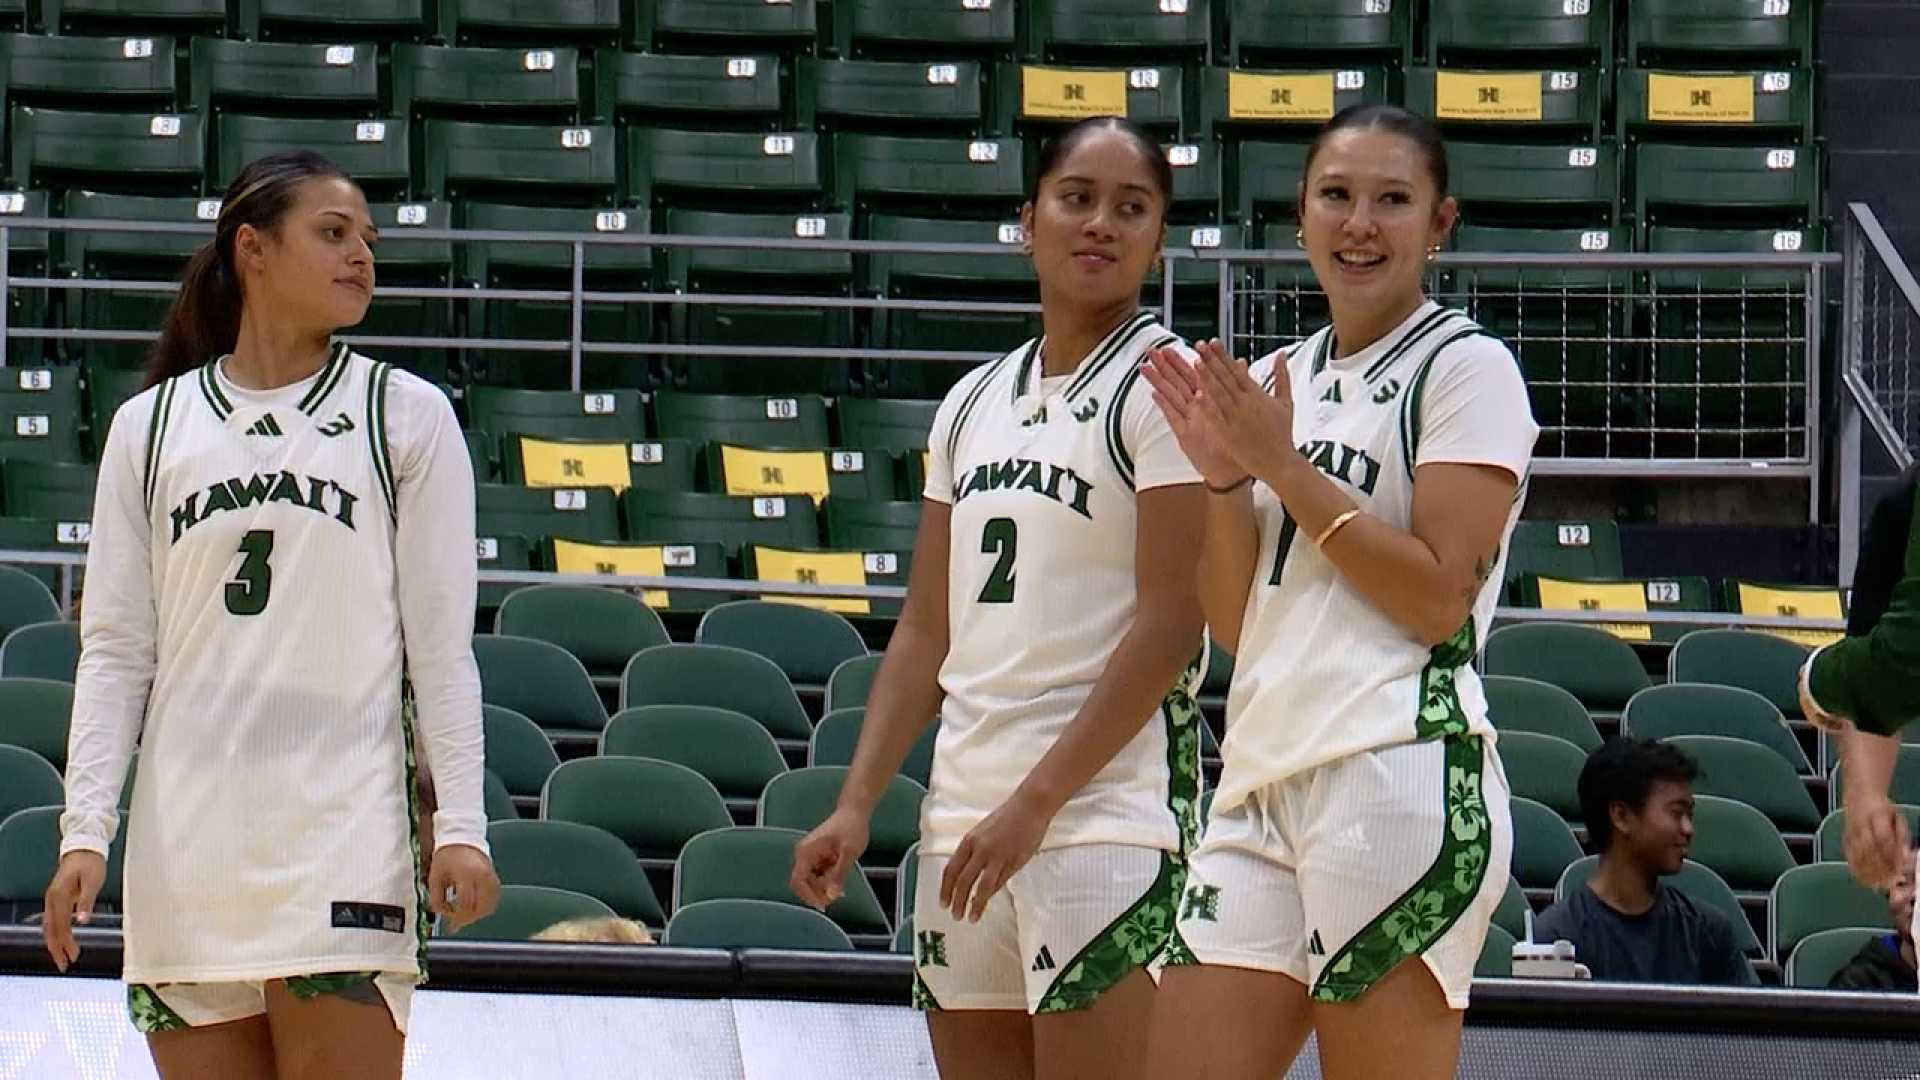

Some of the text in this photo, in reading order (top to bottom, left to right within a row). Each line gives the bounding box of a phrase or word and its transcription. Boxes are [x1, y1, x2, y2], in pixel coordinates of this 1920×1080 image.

[1138, 72, 1154, 86] 13
[1559, 74, 1573, 88] 15
[570, 131, 585, 146] 10
[775, 138, 787, 152] 11
[1576, 151, 1591, 165] 15
[1775, 152, 1790, 166] 16
[207, 203, 217, 218] 8
[407, 206, 416, 221] 9
[604, 213, 619, 229] 10
[806, 220, 818, 235] 11
[1588, 234, 1603, 249] 15
[1782, 234, 1797, 249] 16
[30, 372, 40, 388] 6
[595, 395, 605, 411] 9
[774, 402, 790, 417] 10
[28, 417, 37, 433] 5
[642, 445, 652, 461] 8
[843, 453, 853, 470] 9
[567, 492, 575, 507] 7
[765, 499, 775, 516] 8
[171, 470, 358, 546] HAWAI'I
[68, 525, 79, 542] 4
[1566, 527, 1583, 544] 12
[876, 555, 886, 572] 8
[977, 517, 1018, 604] 2
[225, 530, 274, 616] 3
[1655, 585, 1672, 601] 12
